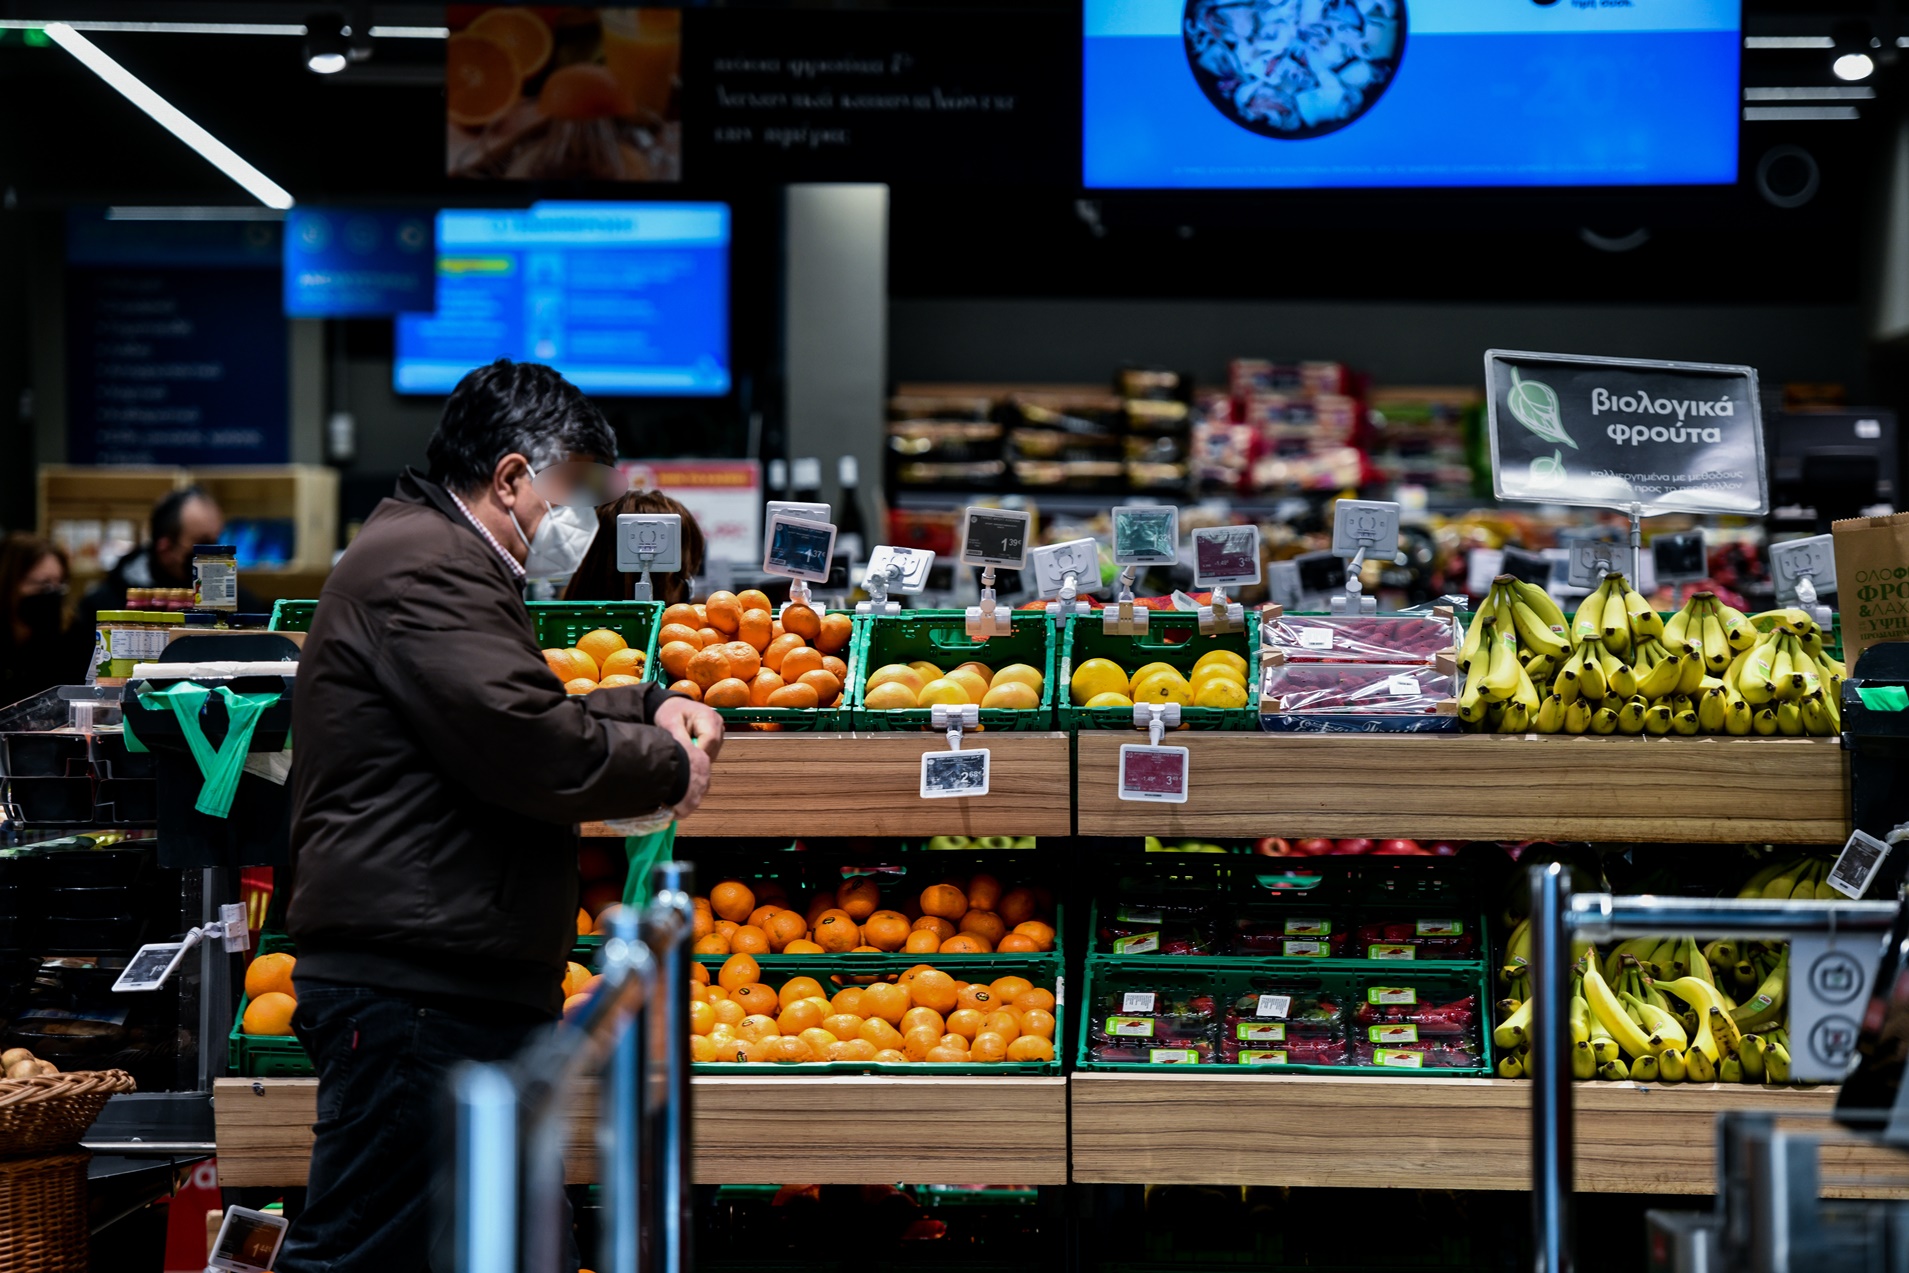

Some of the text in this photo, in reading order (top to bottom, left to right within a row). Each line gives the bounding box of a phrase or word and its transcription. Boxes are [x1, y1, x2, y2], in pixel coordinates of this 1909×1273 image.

[1591, 387, 1734, 420] βιολογικά
[1606, 421, 1721, 446] φρούτα
[1590, 469, 1743, 483] καλλιεργημένα με μεθόδους
[1634, 485, 1662, 493] προς
[1855, 567, 1909, 583] ΟΛΟΦ
